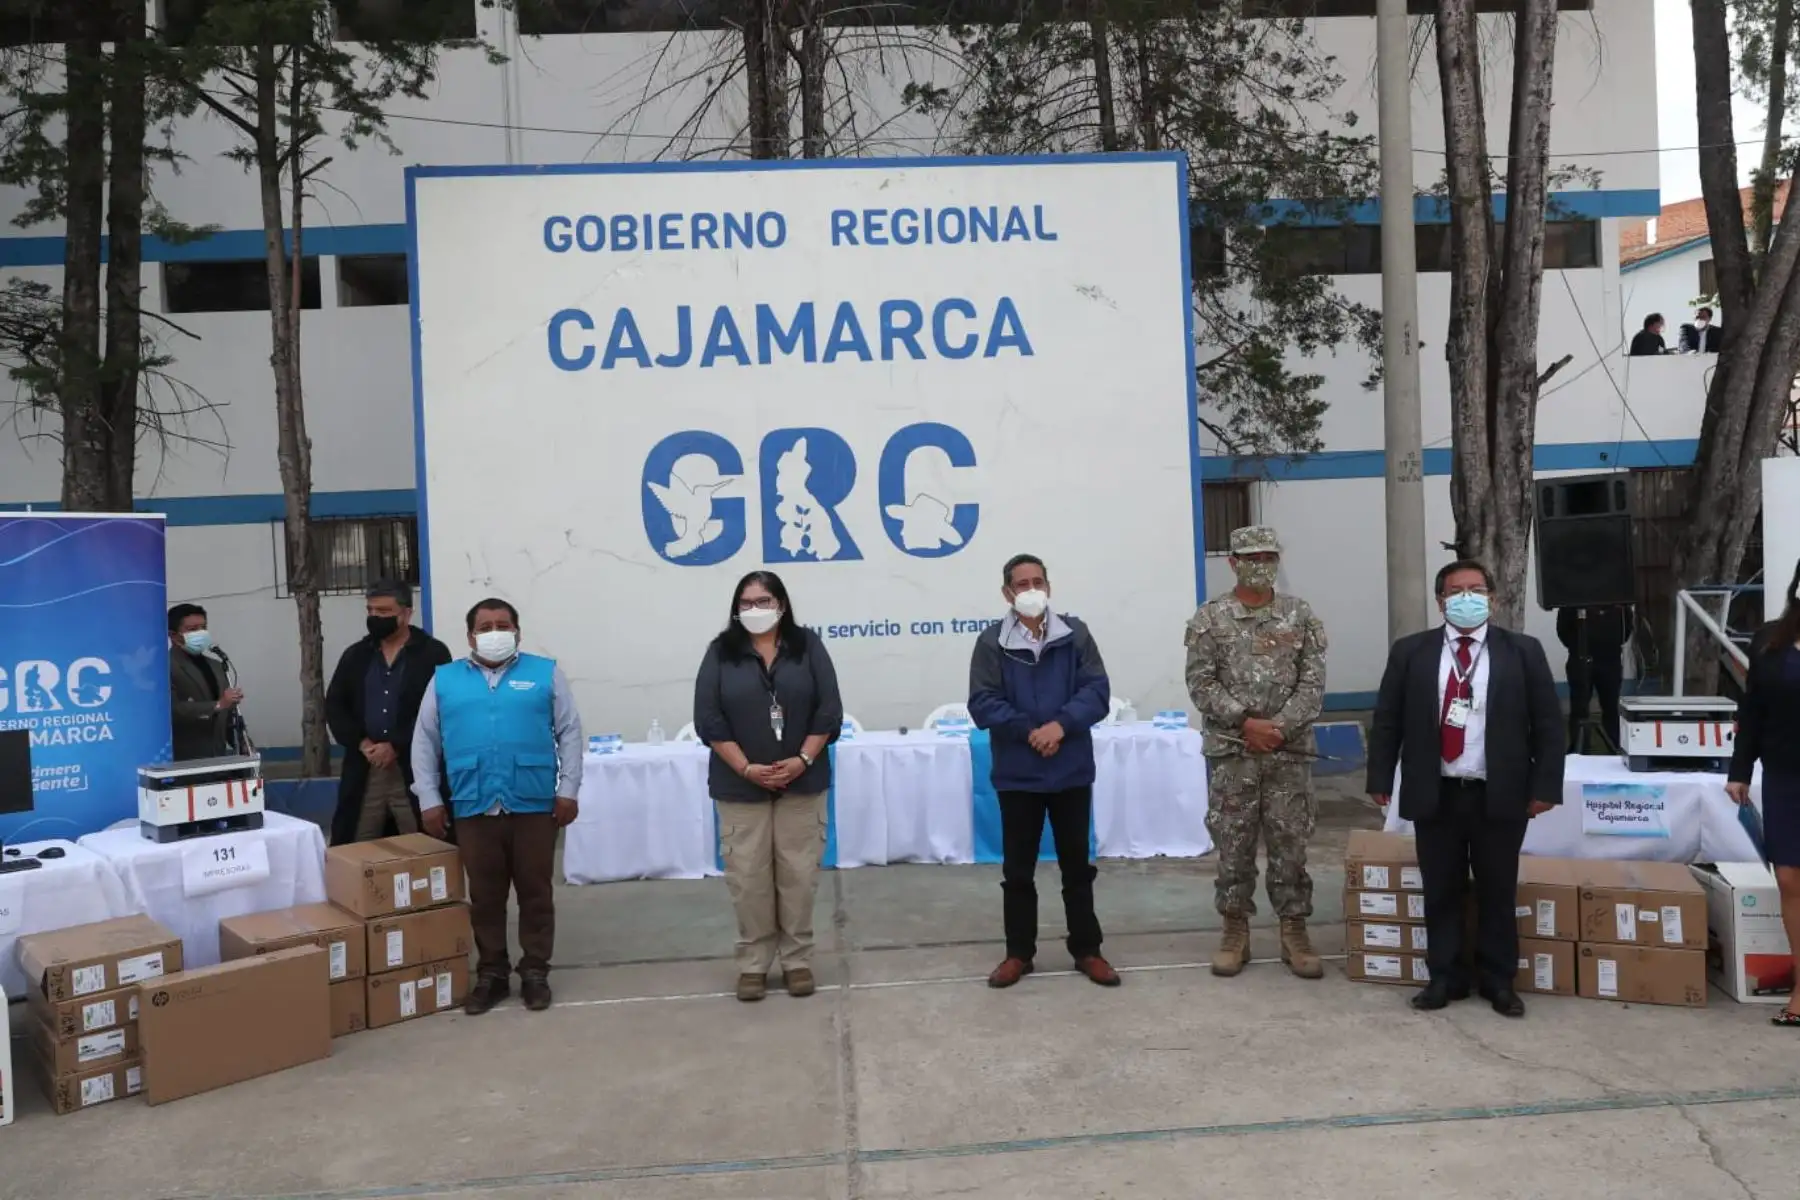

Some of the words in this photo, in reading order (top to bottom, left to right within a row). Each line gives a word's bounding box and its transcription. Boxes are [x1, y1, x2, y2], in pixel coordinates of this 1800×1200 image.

[543, 211, 788, 253] GOBIERNO
[831, 204, 1058, 247] REGIONAL
[547, 296, 1035, 372] CAJAMARCA
[640, 421, 980, 567] GRC
[828, 618, 901, 639] servicio
[910, 620, 944, 635] con
[0, 656, 112, 713] RC
[42, 711, 114, 729] REGIONAL
[1586, 800, 1622, 811] Hospital
[1624, 801, 1664, 813] Regional
[1598, 811, 1649, 823] Cajamarca
[213, 846, 236, 862] 131
